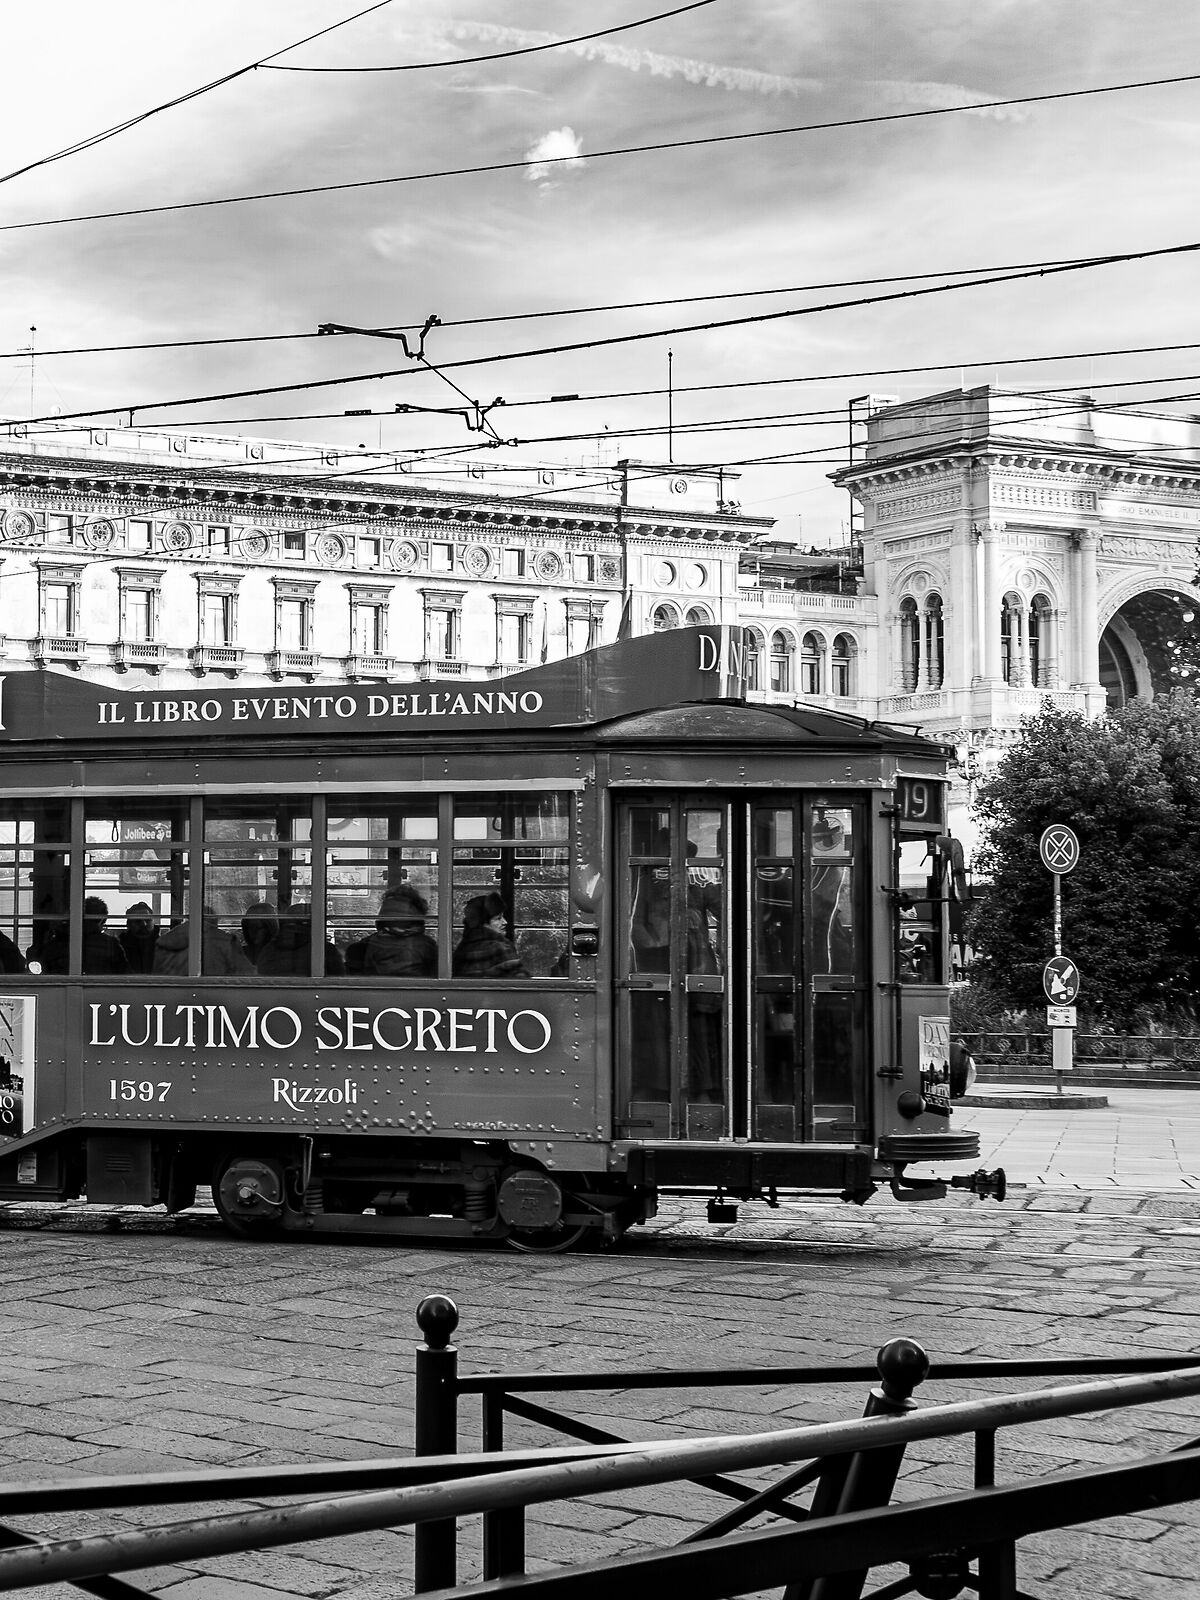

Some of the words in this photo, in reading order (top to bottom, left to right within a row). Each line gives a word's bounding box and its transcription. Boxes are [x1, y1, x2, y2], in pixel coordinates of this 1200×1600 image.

[97, 703, 126, 724] IL
[134, 700, 222, 723] LIBRO
[231, 695, 356, 720] EVENTO
[366, 690, 543, 718] DELL'ANNO
[903, 781, 928, 818] 19
[124, 827, 156, 840] Jollibee
[89, 1003, 302, 1049] L'ULTIMO
[315, 1008, 552, 1054] SEGRETO
[109, 1079, 172, 1102] 1597
[271, 1078, 358, 1115] Rizzoli
